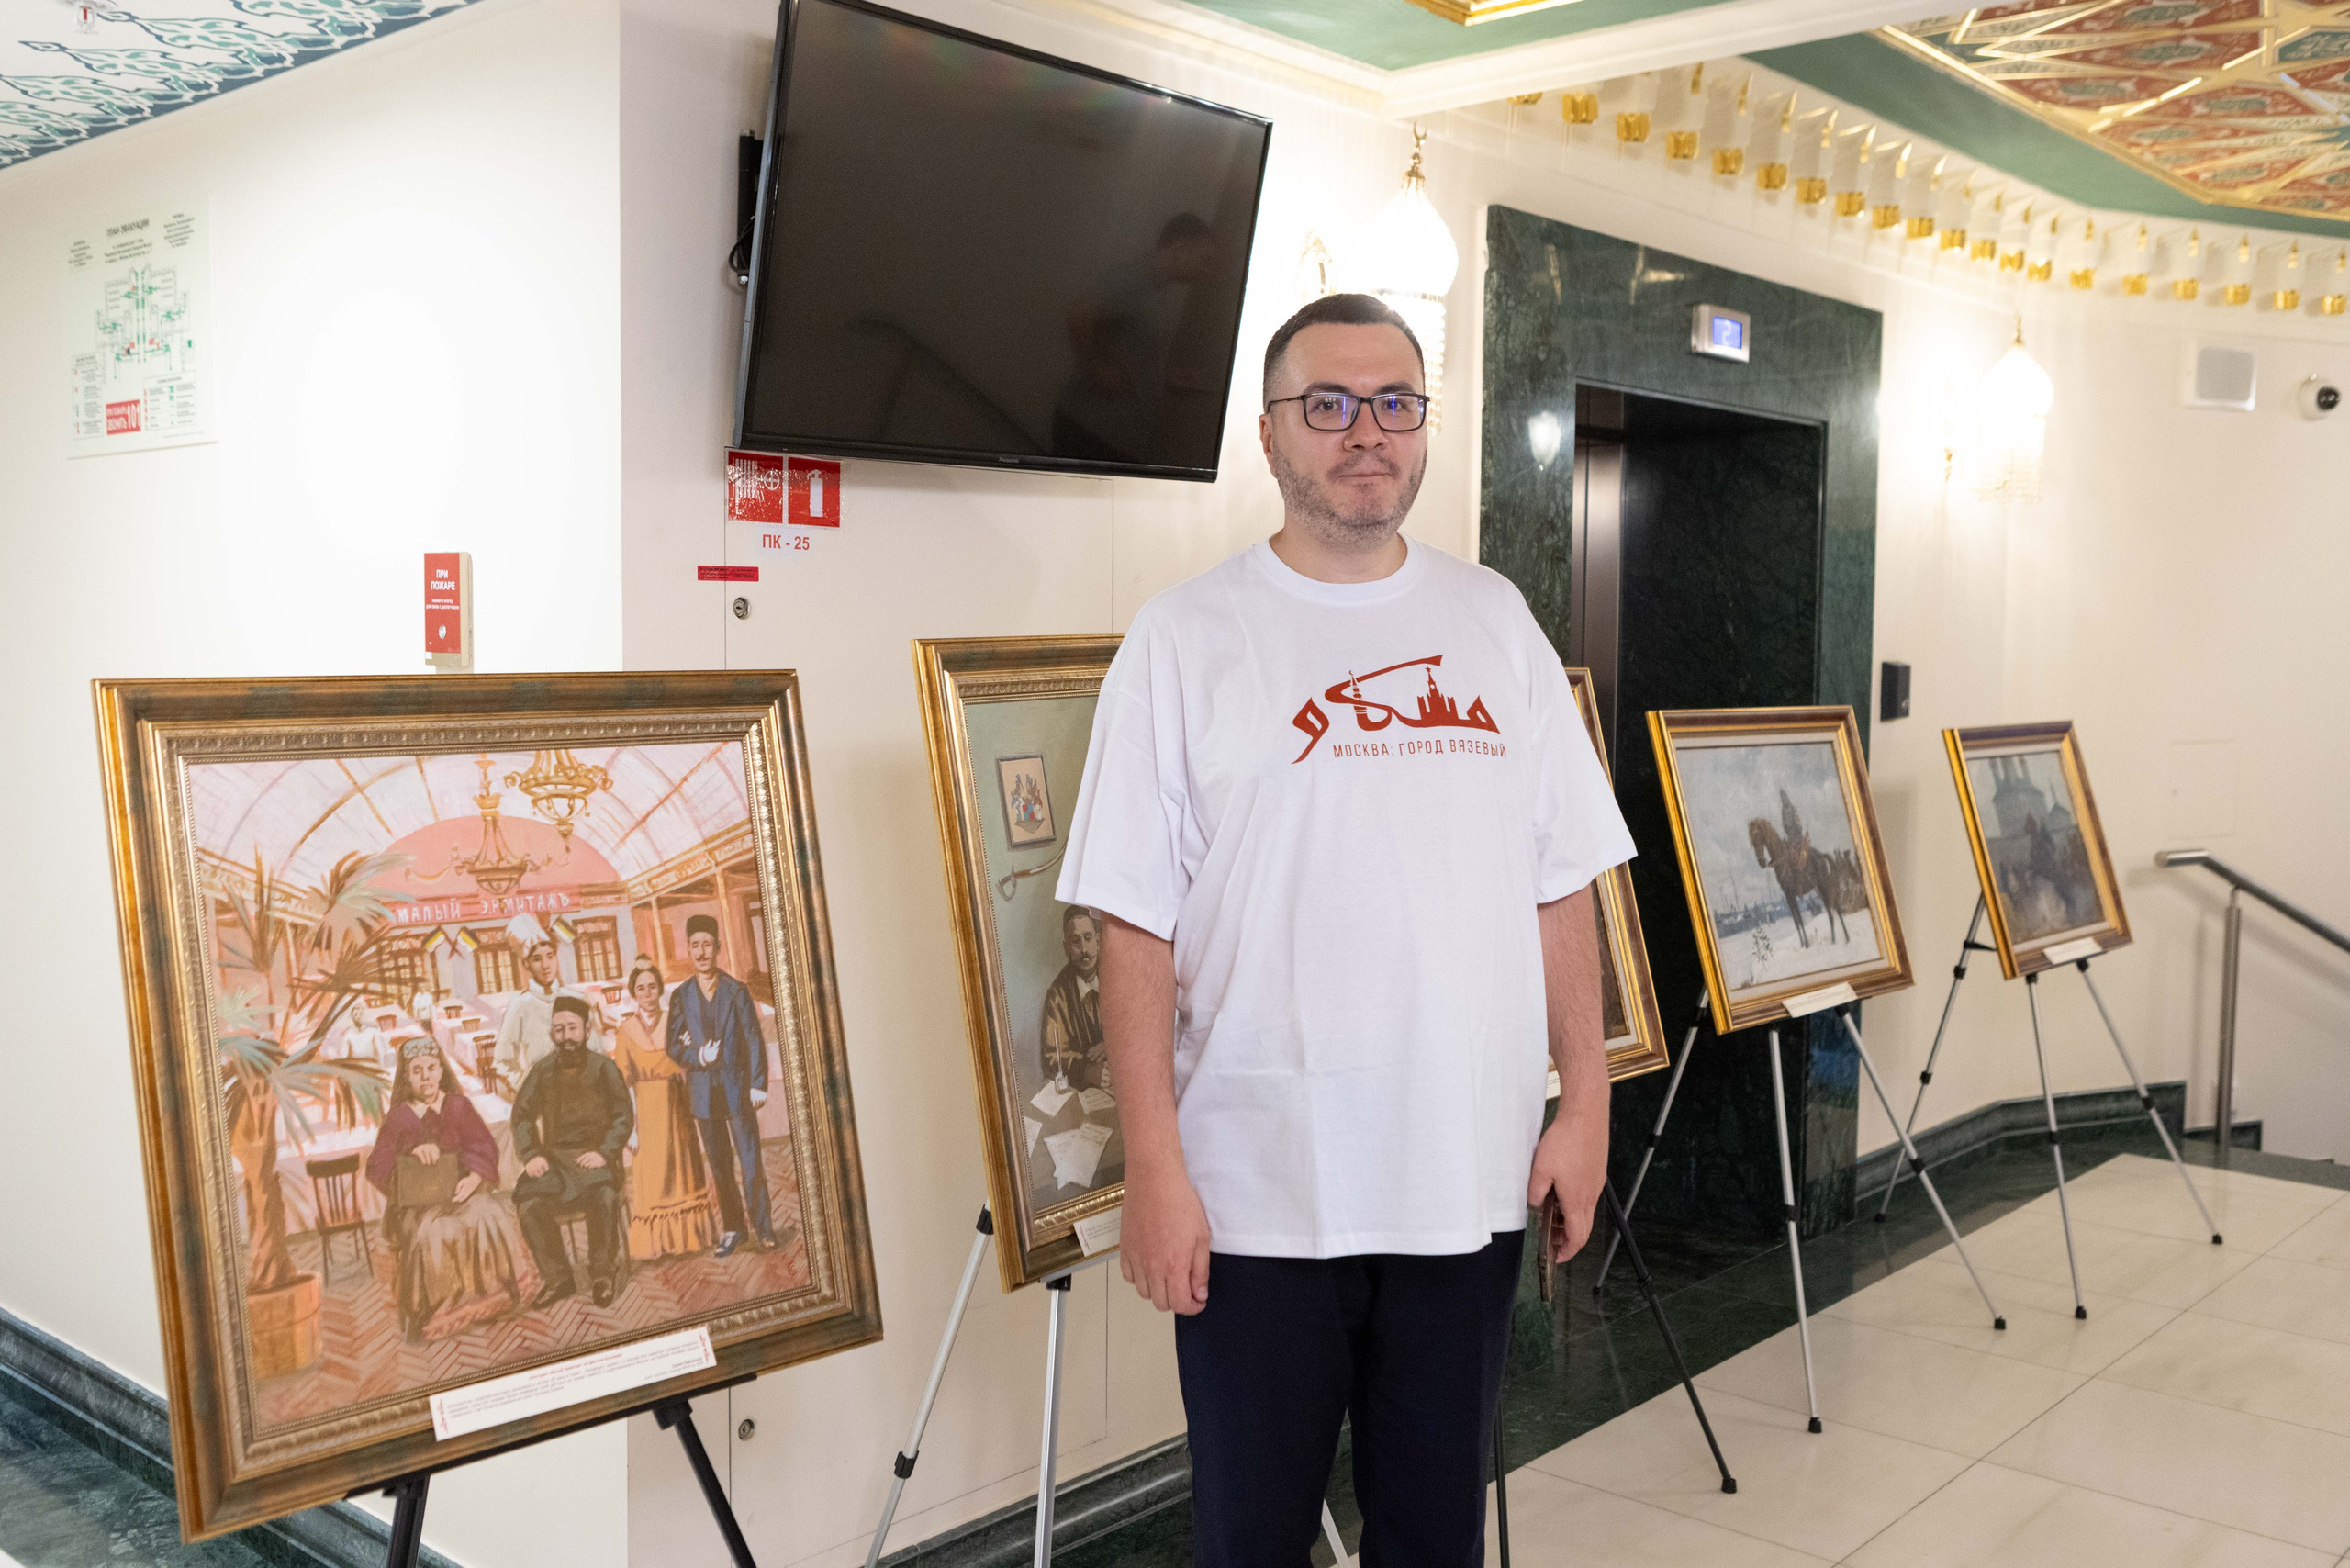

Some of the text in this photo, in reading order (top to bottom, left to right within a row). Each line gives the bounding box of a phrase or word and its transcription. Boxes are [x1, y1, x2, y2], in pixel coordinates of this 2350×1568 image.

[762, 534, 781, 549] ПК
[793, 536, 810, 551] 25
[436, 569, 448, 579] ПРИ
[431, 581, 455, 590] ПОЖАРЕ
[1399, 739, 1444, 756] ГОРОД
[1449, 739, 1507, 758] ВЯЗЕВЫЙ
[397, 892, 570, 924] МАЛЫЙ ЭРМИТАЖЪ
